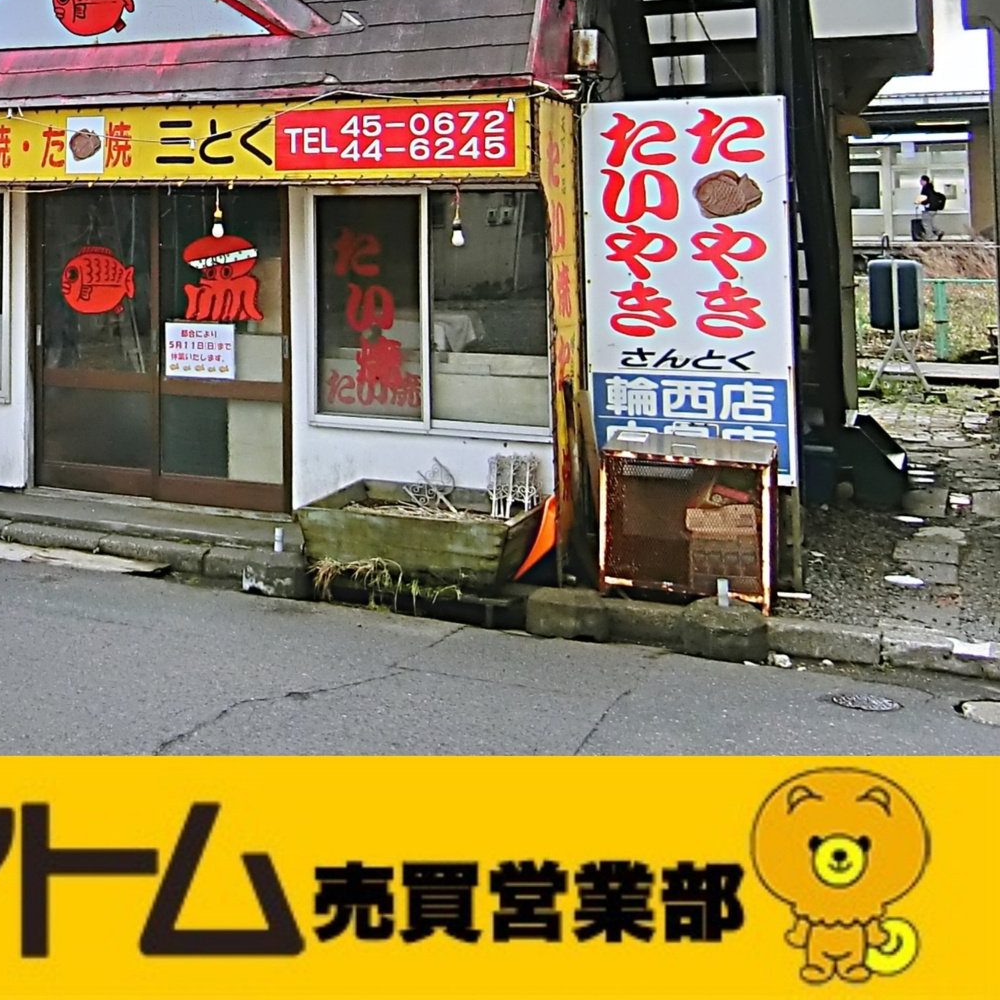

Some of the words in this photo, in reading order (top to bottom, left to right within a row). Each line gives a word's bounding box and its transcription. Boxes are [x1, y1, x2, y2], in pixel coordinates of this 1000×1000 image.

[156, 117, 273, 166] 三とく
[284, 127, 339, 154] TEL
[339, 110, 506, 138] 45-0672
[339, 137, 507, 163] 44-6245
[600, 112, 679, 337] たいやき
[686, 109, 767, 339] たやき
[621, 347, 756, 371] さんとく
[605, 375, 775, 422] 輪西店
